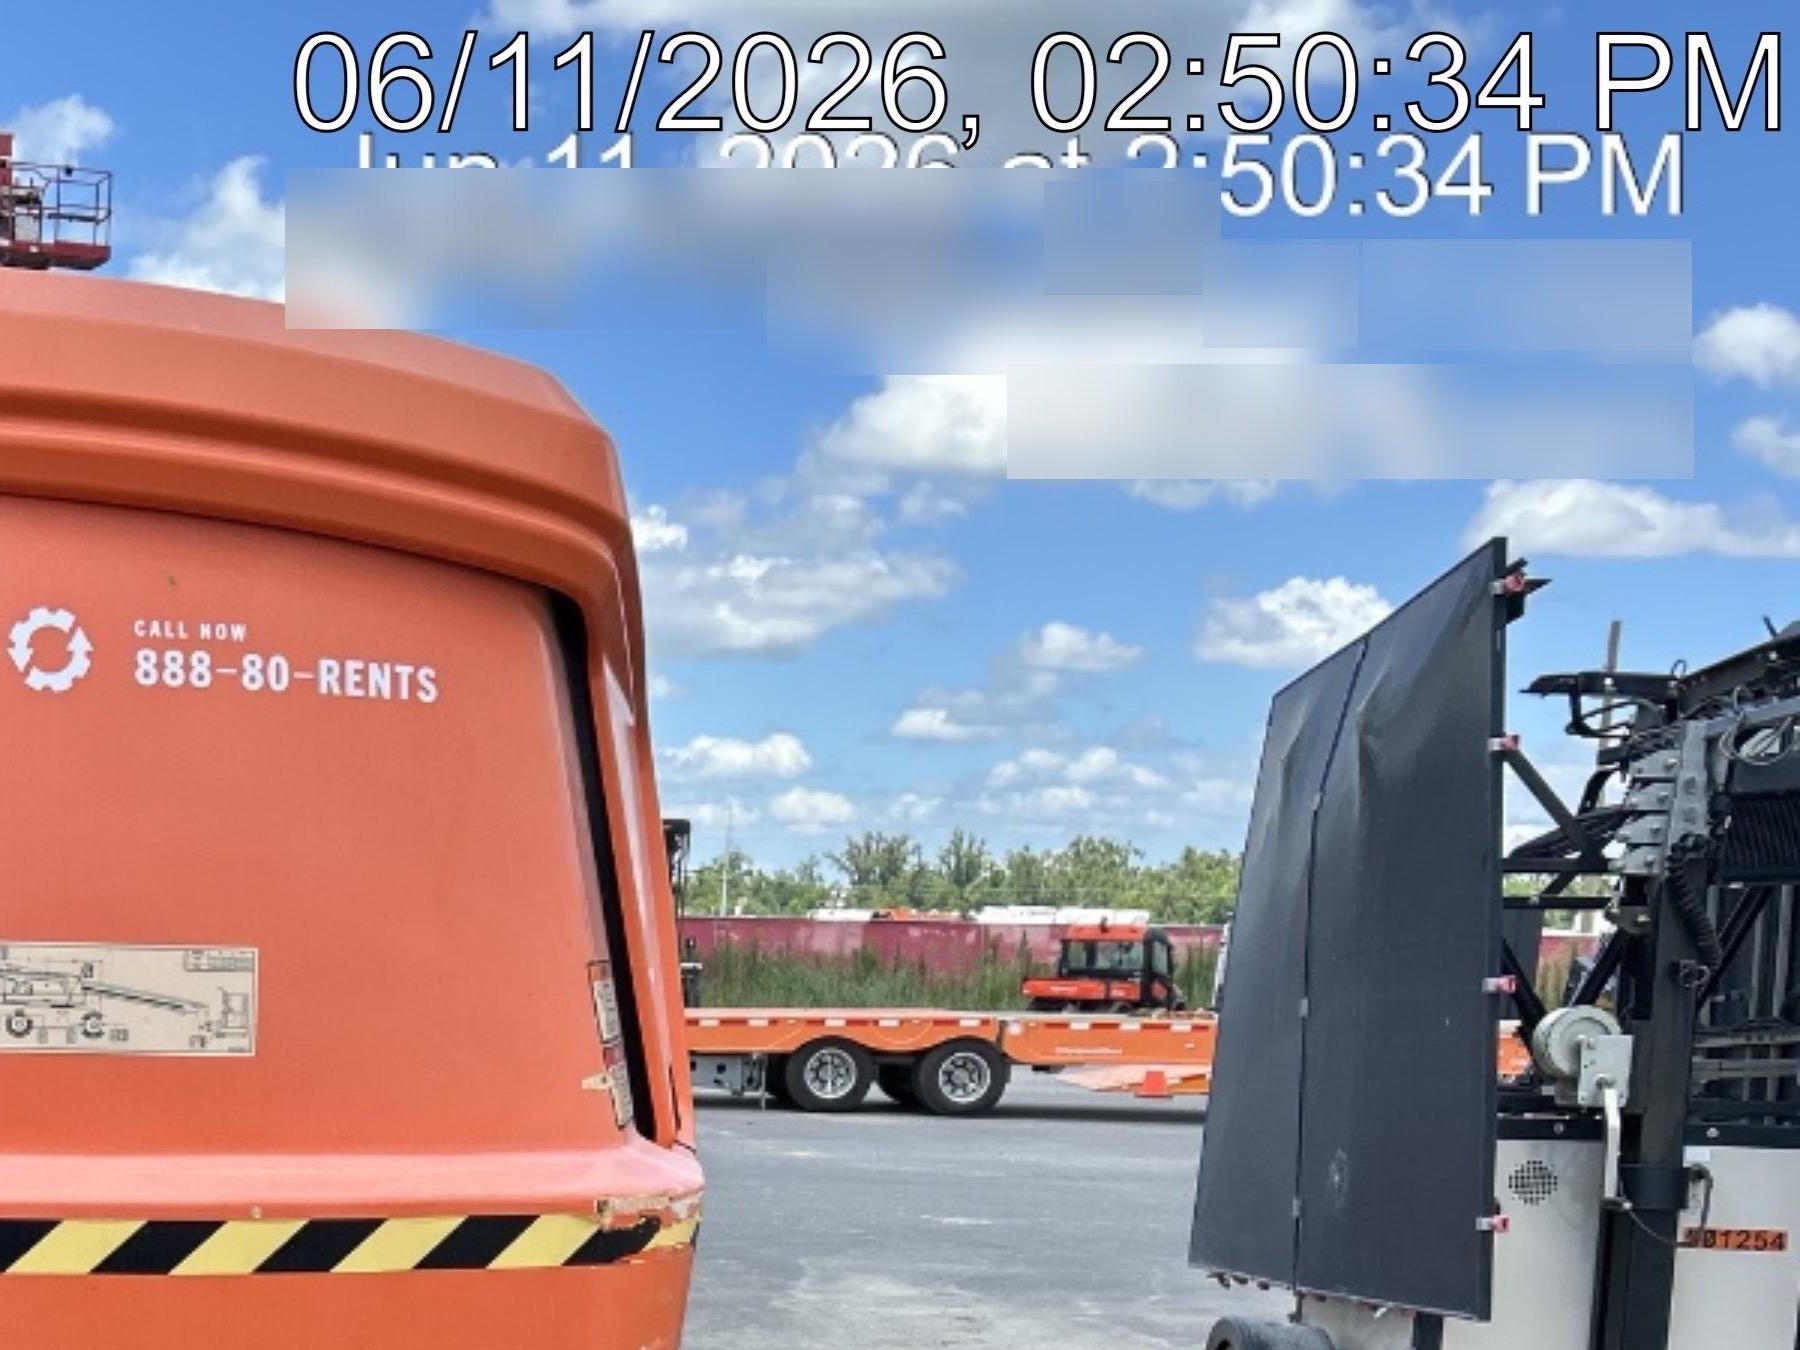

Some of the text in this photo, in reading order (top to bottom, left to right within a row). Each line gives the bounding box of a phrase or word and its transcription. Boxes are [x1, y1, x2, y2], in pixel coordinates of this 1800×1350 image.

[133, 620, 248, 642] CALL NOW
[134, 648, 439, 703] 888-80-RENTS
